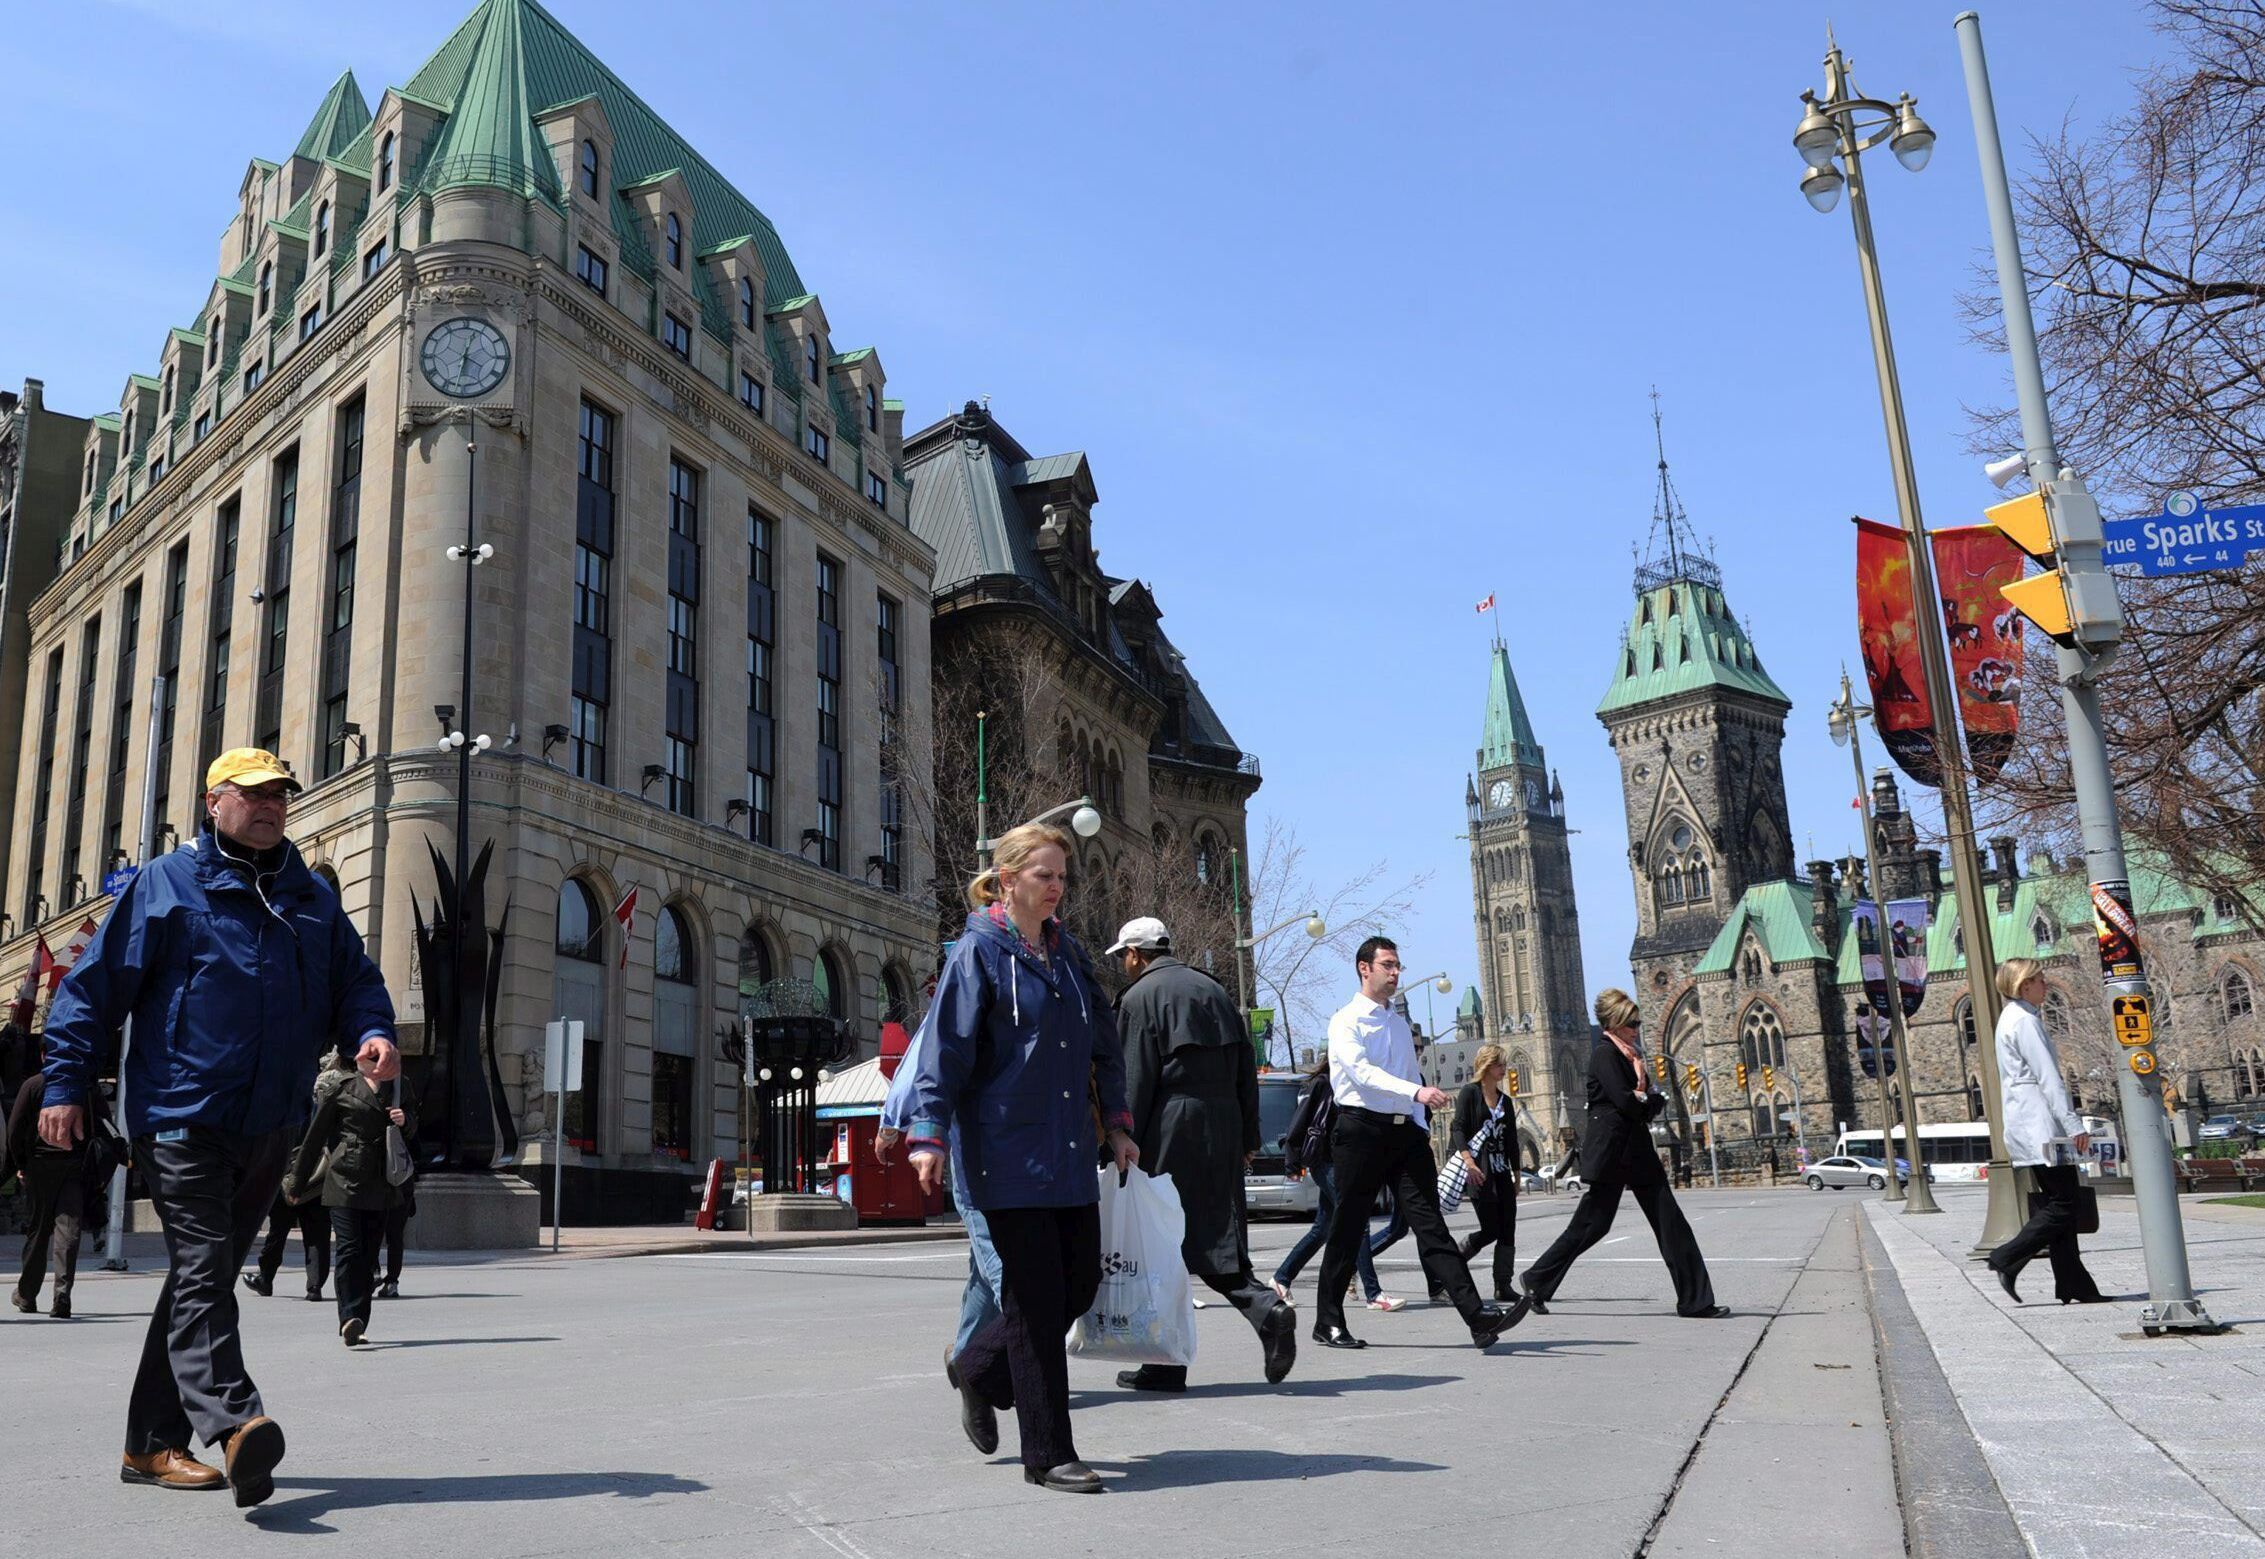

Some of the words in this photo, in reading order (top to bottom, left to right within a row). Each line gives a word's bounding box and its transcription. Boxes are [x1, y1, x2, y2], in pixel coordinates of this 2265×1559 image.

[2107, 538, 2136, 554] rue
[2143, 514, 2237, 555] Sparks
[2245, 519, 2265, 538] St
[2157, 555, 2175, 568] 440
